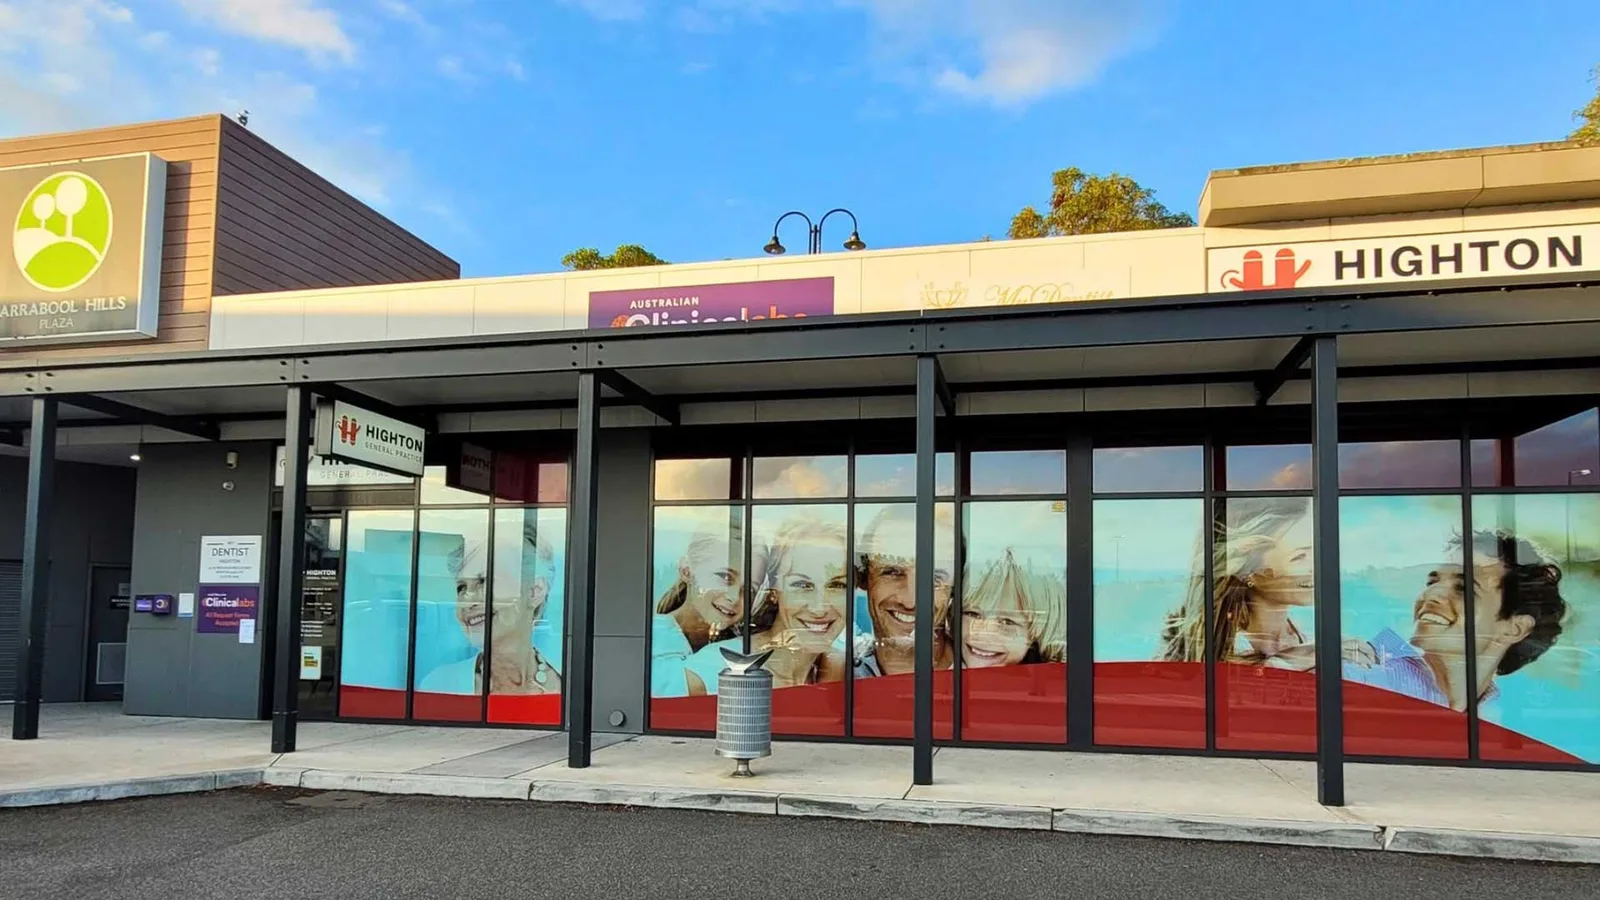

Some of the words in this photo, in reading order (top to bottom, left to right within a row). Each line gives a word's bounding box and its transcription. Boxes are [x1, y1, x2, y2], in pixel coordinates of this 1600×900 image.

[1335, 235, 1583, 280] HIGHTON
[0, 300, 78, 317] ARRABOOL
[85, 296, 126, 312] HILLS
[630, 297, 699, 309] AUSTRALIAN
[39, 318, 74, 329] PLAZA
[366, 424, 423, 453] HIGHTON
[365, 441, 394, 456] GENERAL
[396, 449, 423, 464] PRACTICE
[212, 547, 249, 557] DENTIST
